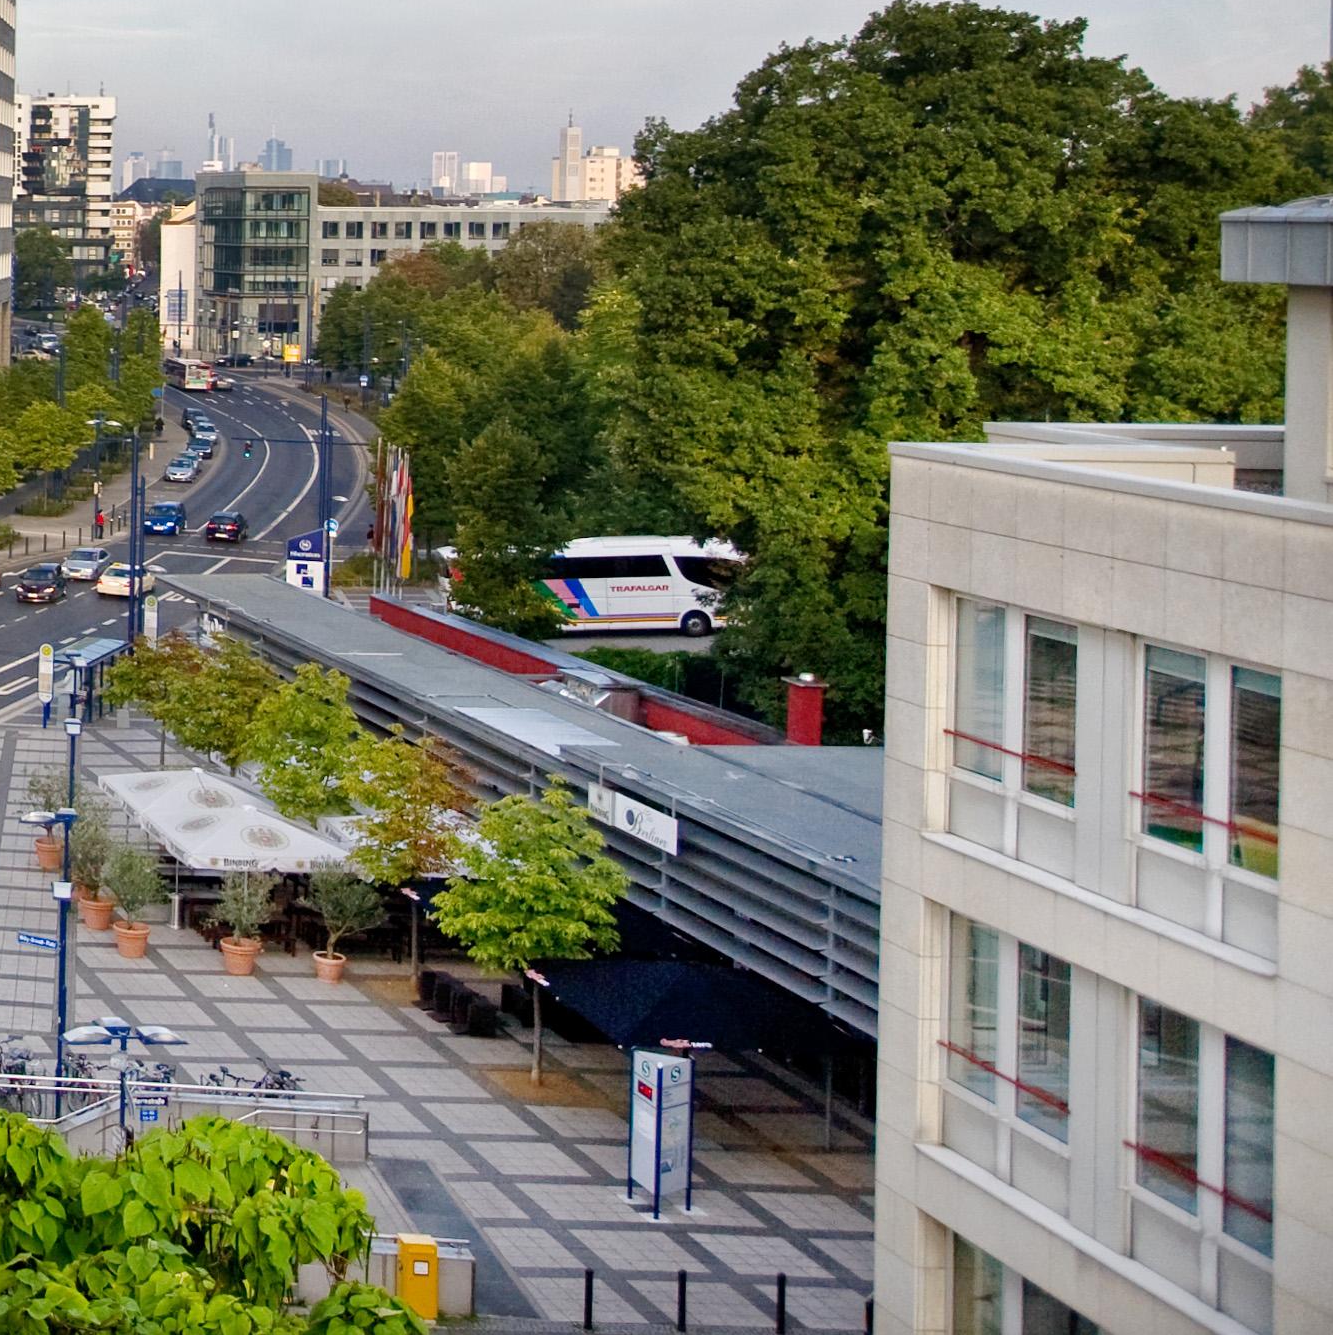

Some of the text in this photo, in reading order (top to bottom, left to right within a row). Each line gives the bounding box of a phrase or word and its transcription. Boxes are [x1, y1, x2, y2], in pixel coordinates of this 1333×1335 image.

[609, 584, 670, 593] TRAFALGAR
[628, 811, 669, 848] Berliner
[223, 857, 259, 868] BINDING
